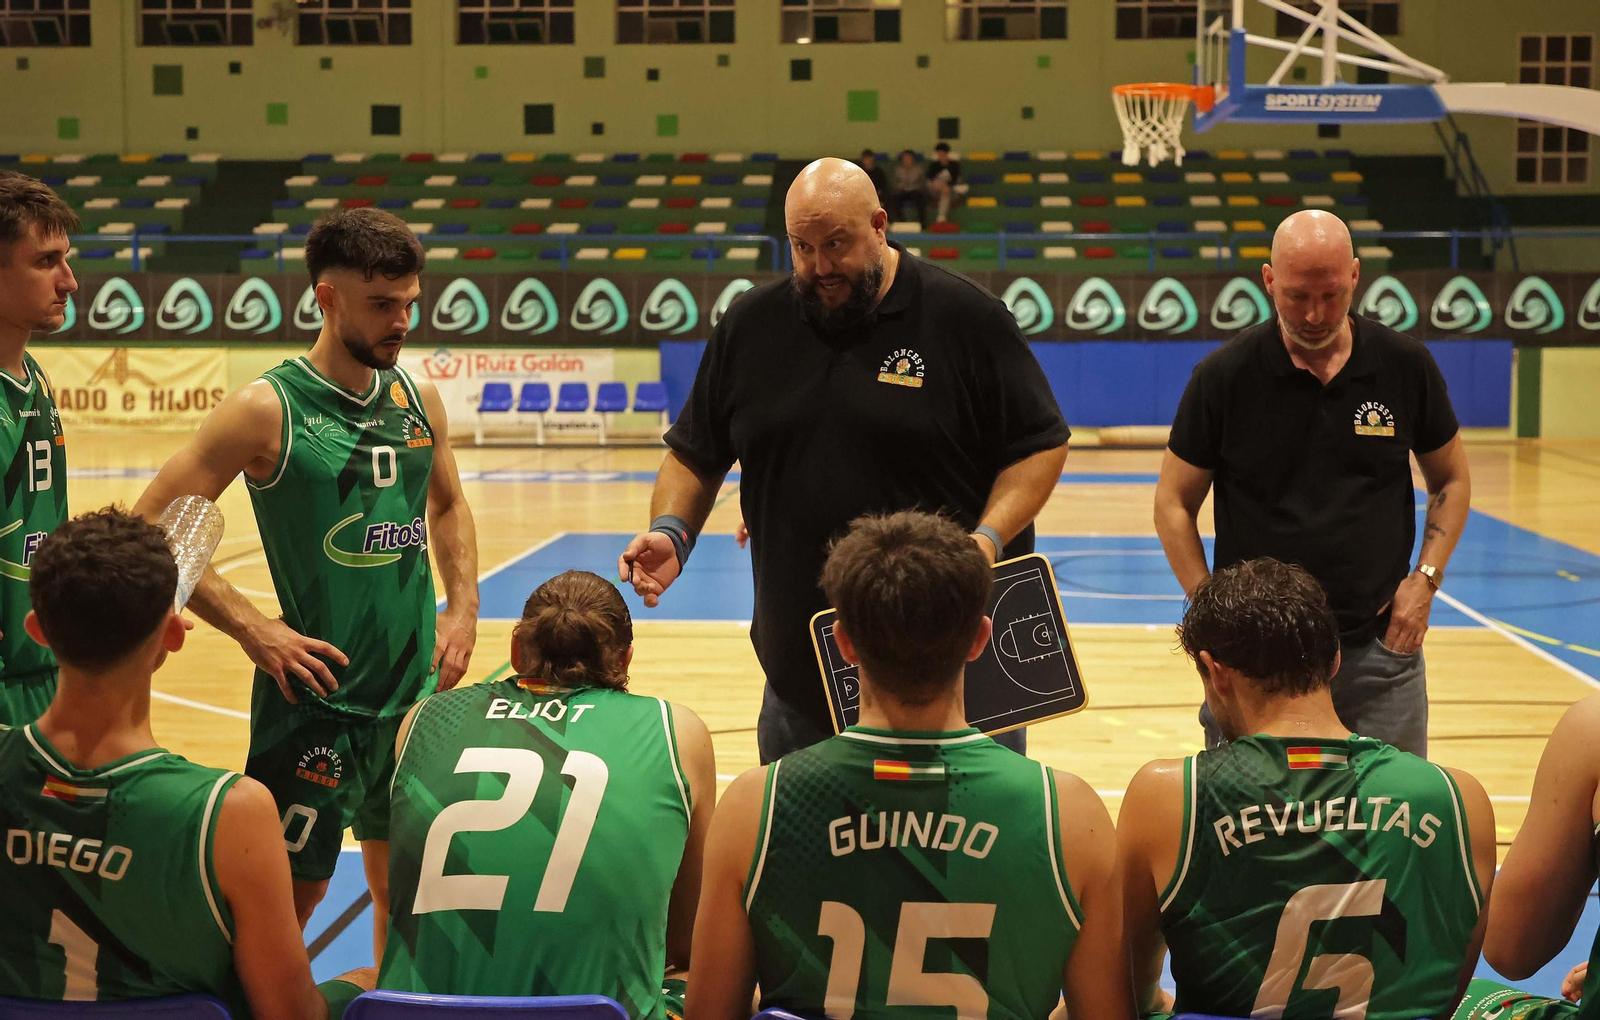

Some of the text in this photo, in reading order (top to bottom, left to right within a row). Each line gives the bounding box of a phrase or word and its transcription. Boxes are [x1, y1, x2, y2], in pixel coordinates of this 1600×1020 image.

[476, 354, 516, 372] Ruiz
[880, 349, 925, 377] BALONCESTO
[123, 391, 135, 410] e
[151, 388, 225, 411] HIJOS
[1354, 401, 1394, 426] BALONCESTO
[27, 440, 52, 492] 13
[371, 445, 397, 488] 0
[485, 699, 595, 722] ELIOT
[298, 746, 342, 779] BALONCESTO
[281, 804, 318, 852] 0
[412, 747, 609, 915] 21
[829, 811, 999, 859] GUINDO
[1213, 796, 1442, 857] REVUELTAS
[6, 829, 133, 881] DIEGO
[48, 909, 99, 1001] 1
[817, 901, 997, 1020] 15
[1250, 879, 1387, 1020] 6
